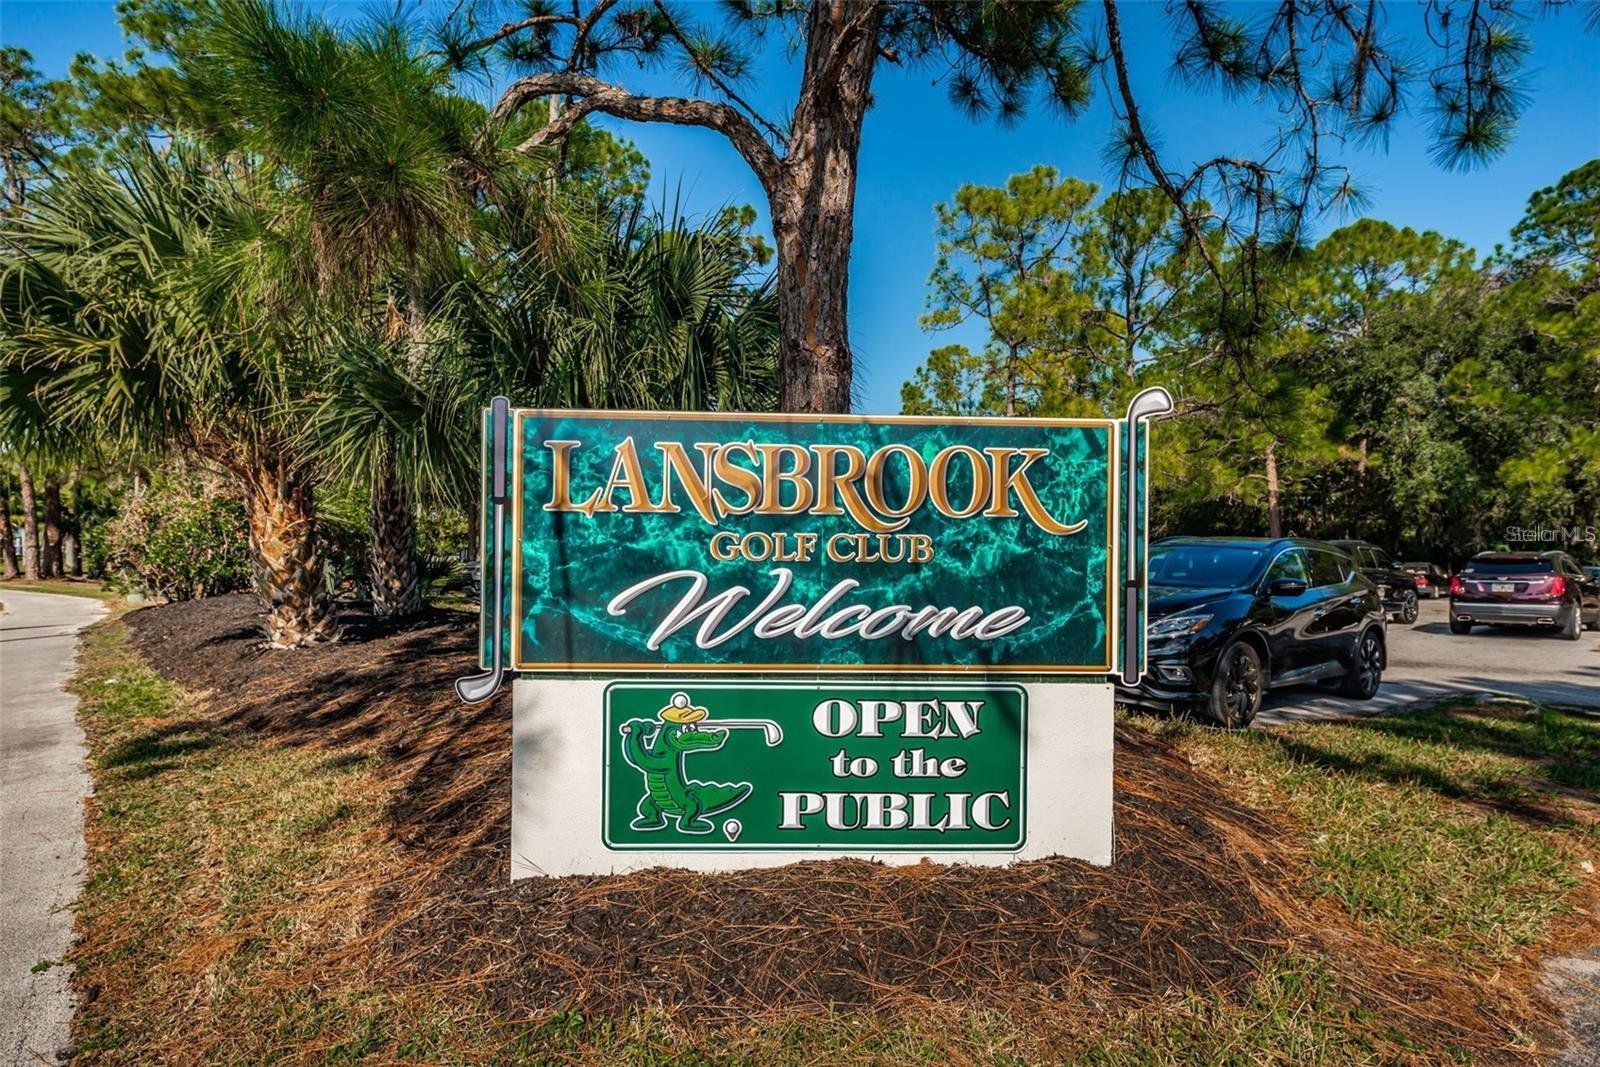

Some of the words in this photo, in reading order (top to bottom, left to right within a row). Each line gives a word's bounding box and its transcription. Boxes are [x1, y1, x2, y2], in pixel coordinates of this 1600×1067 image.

[543, 437, 1088, 534] LANSBROOK
[710, 531, 818, 562] GOLF
[828, 533, 934, 563] CLUB
[607, 569, 1030, 650] Welcome
[812, 698, 985, 739] OPEN
[830, 749, 879, 778] to
[890, 748, 967, 778] the
[778, 791, 1011, 832] PUBLIC
